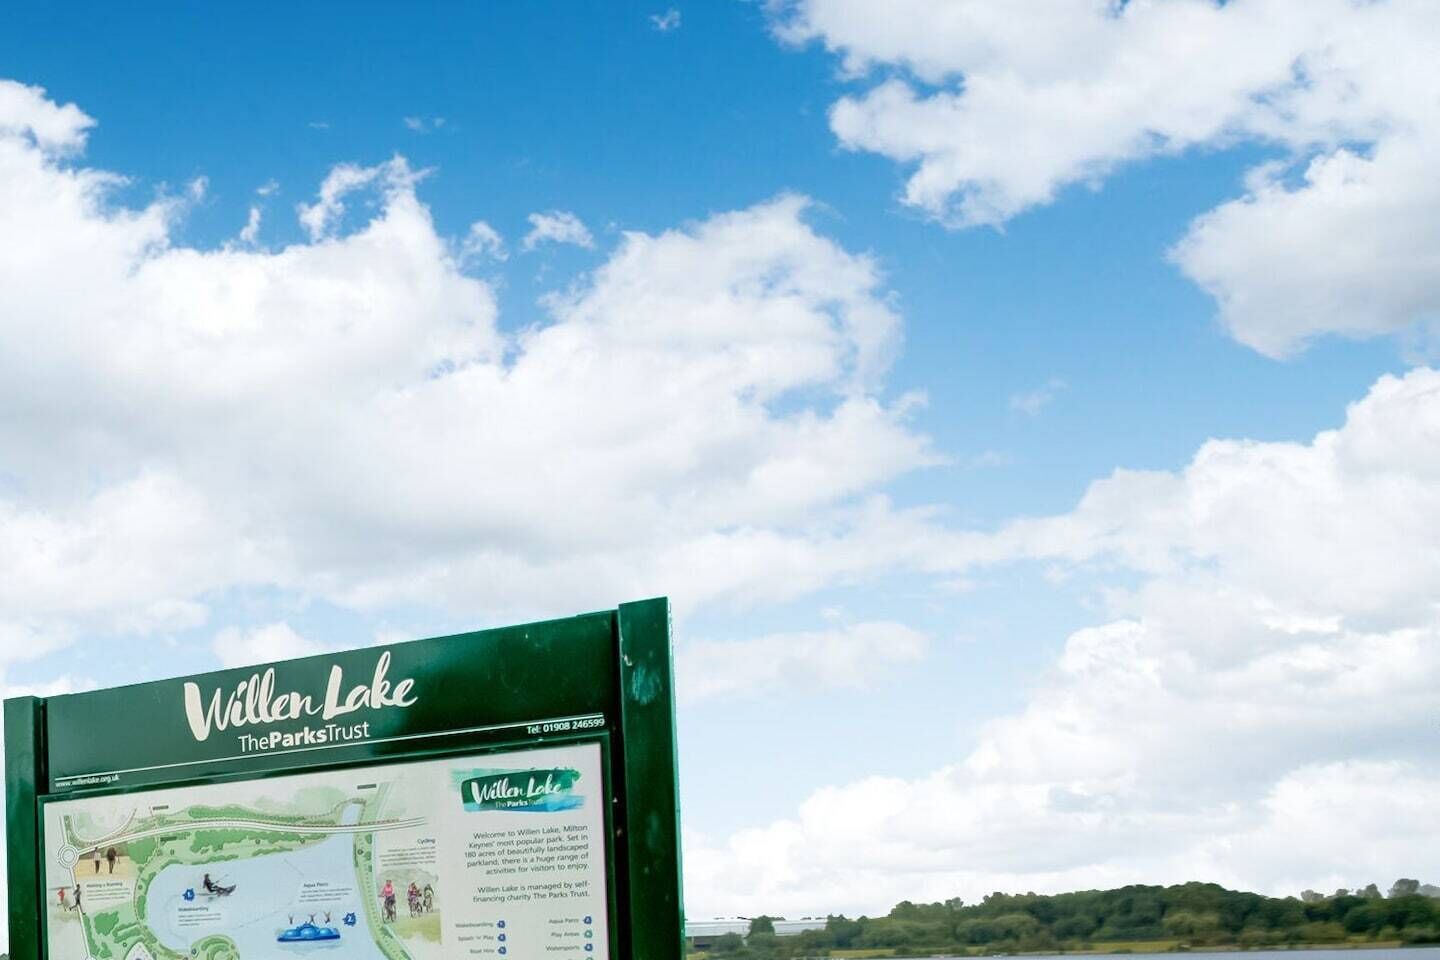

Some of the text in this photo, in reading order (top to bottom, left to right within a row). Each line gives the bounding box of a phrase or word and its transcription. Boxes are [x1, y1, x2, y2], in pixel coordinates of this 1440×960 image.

[183, 651, 418, 741] Willen Lake
[543, 722, 570, 733] 01908
[572, 718, 606, 730] 246599
[471, 774, 561, 805] Willen Lake
[473, 831, 506, 839] Welcome
[517, 828, 540, 836] Willen
[516, 838, 544, 847] popular
[507, 847, 545, 856] beautifully
[547, 844, 589, 853] landscaped
[536, 855, 555, 863] huge
[557, 854, 578, 862] range
[527, 882, 562, 891] managed
[473, 895, 505, 903] financing
[506, 893, 531, 901] charity
